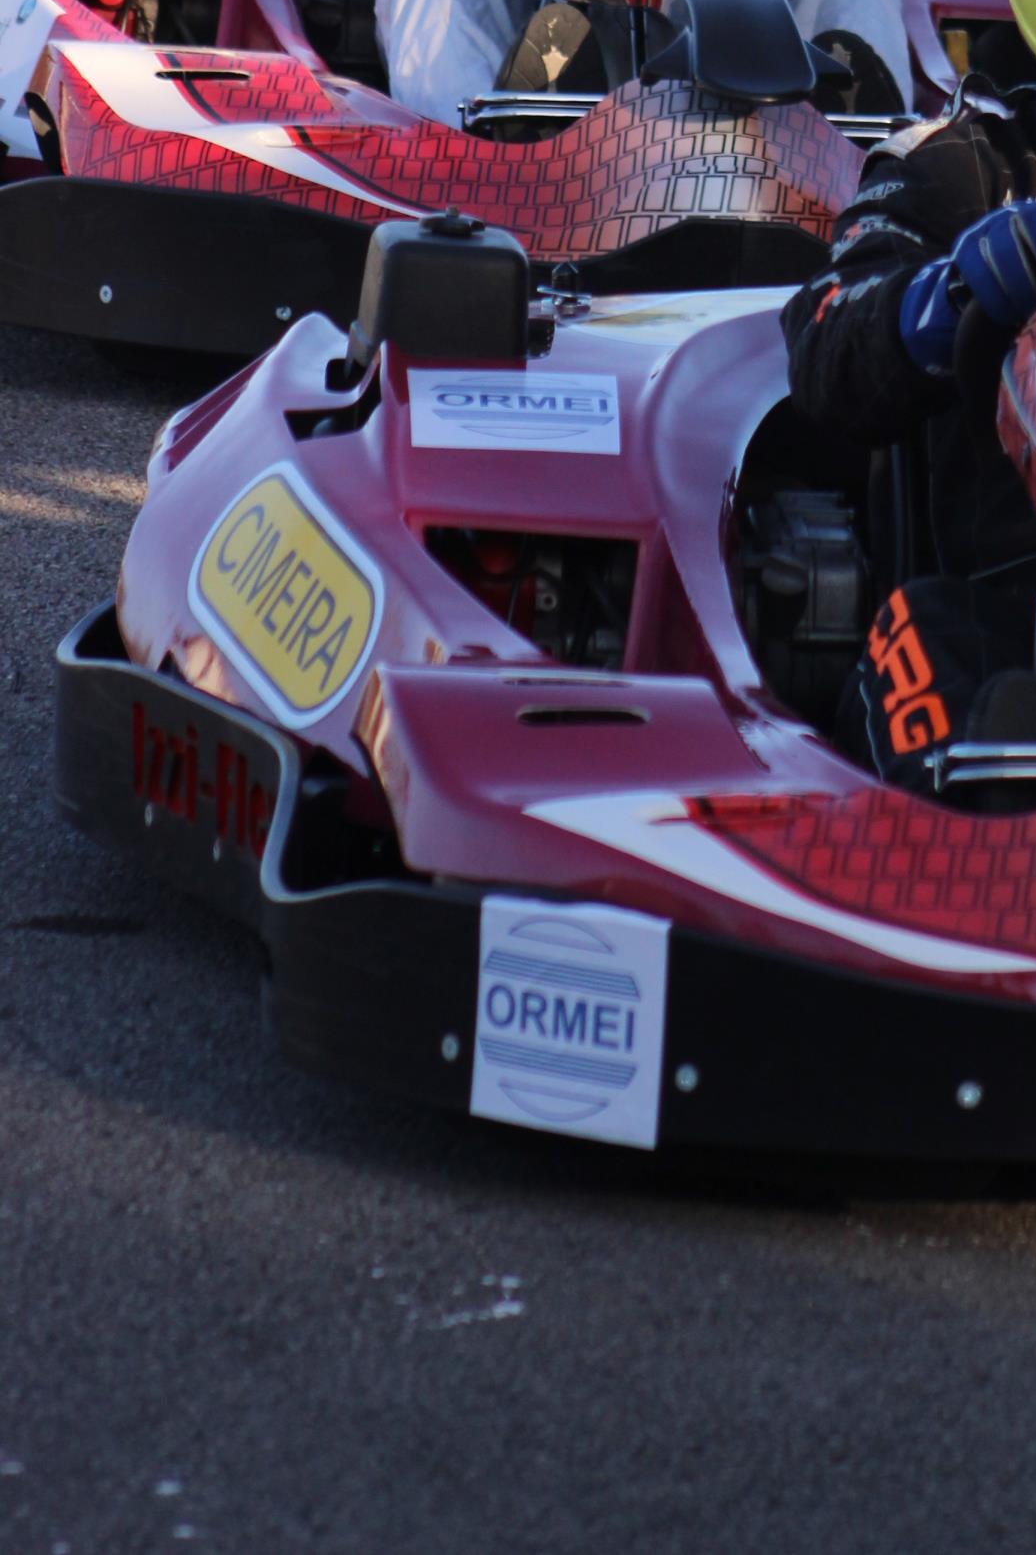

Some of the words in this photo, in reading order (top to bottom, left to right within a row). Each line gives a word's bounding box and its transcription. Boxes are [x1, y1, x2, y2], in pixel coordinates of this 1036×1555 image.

[435, 391, 609, 414] ORMEI
[215, 504, 353, 693] CIMEIRA
[486, 983, 635, 1054] ORMEI
